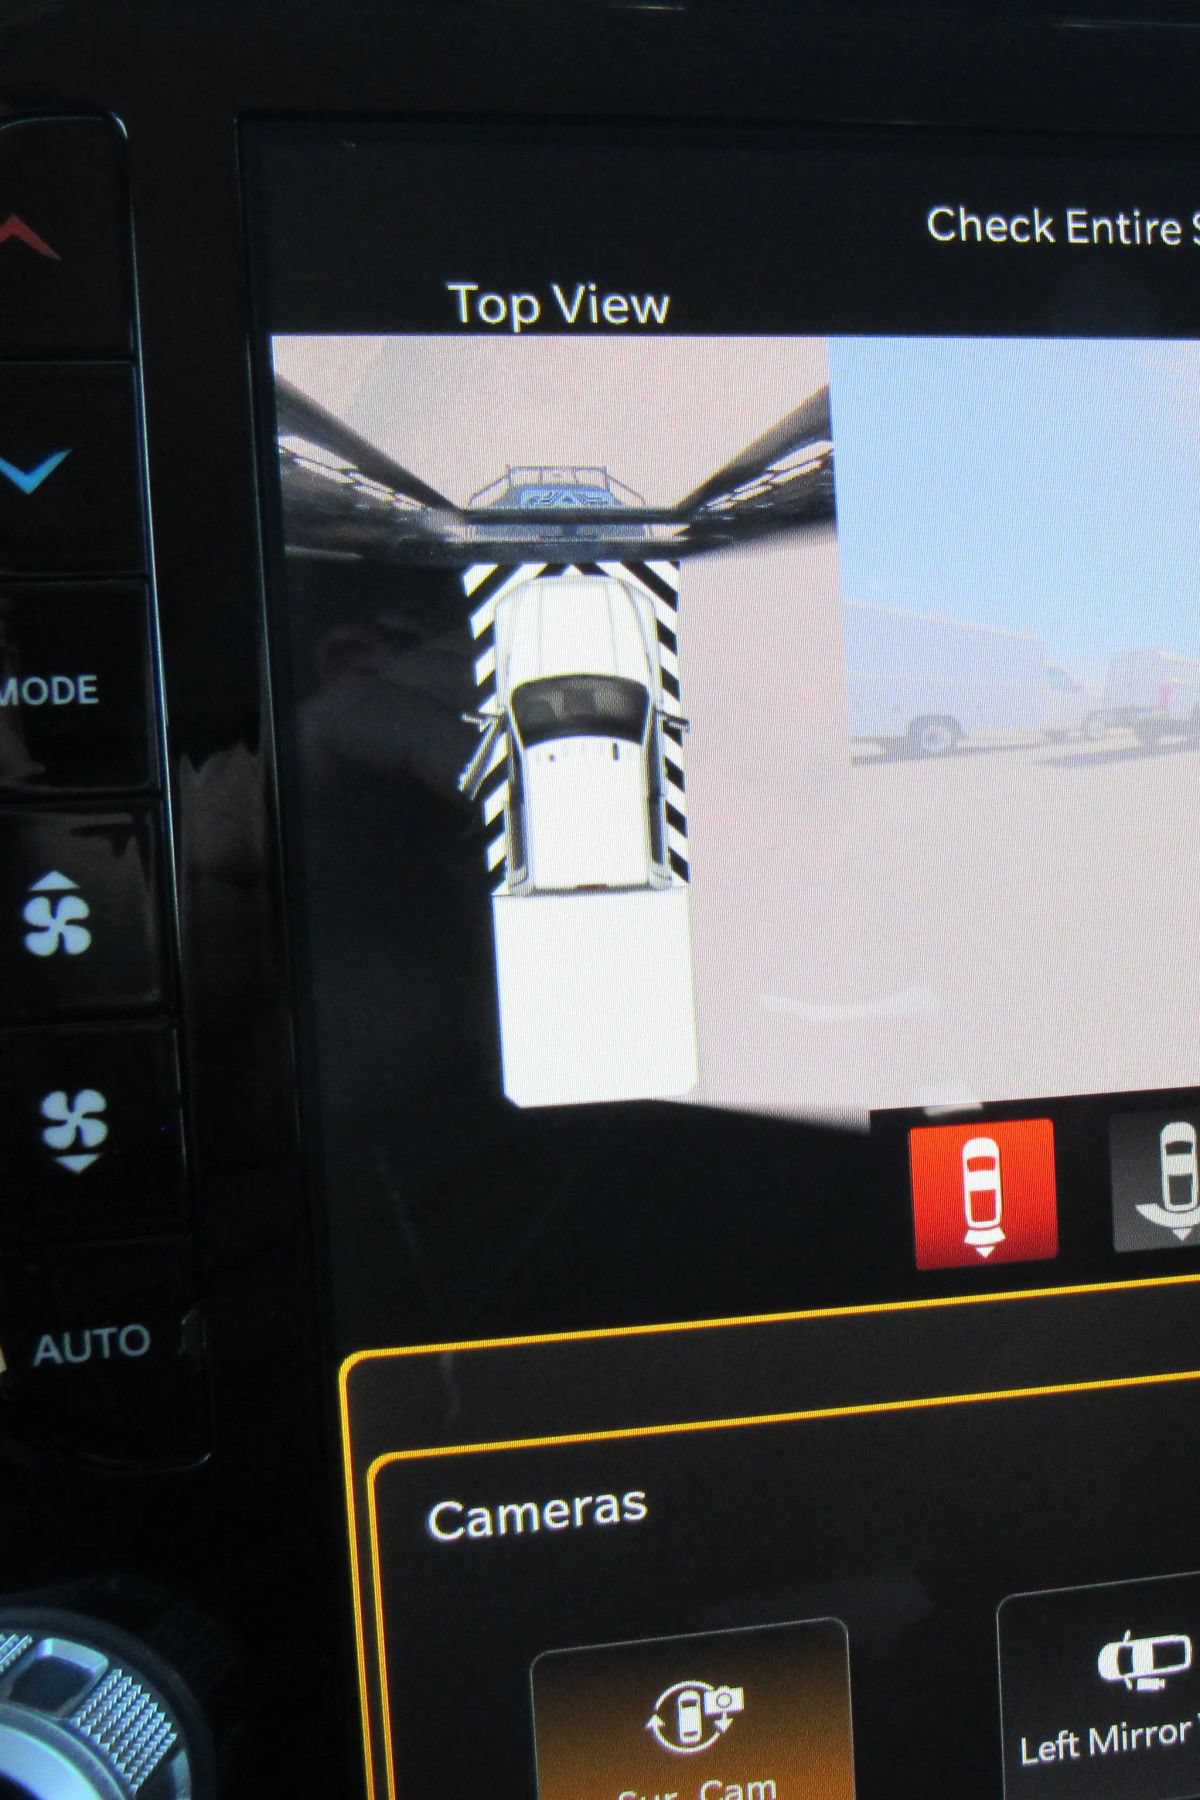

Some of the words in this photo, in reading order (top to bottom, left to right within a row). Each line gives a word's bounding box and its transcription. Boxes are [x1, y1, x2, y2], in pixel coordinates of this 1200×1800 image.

[927, 204, 1056, 243] Check
[1066, 207, 1182, 246] Entire
[446, 282, 541, 333] Top
[551, 282, 671, 326] View
[0, 674, 99, 707] MODE
[33, 1323, 152, 1367] AUTO
[427, 1490, 648, 1543] Cameras
[1020, 1729, 1080, 1767] Left
[1088, 1720, 1192, 1757] Mirror
[700, 1779, 777, 1800] Cam
